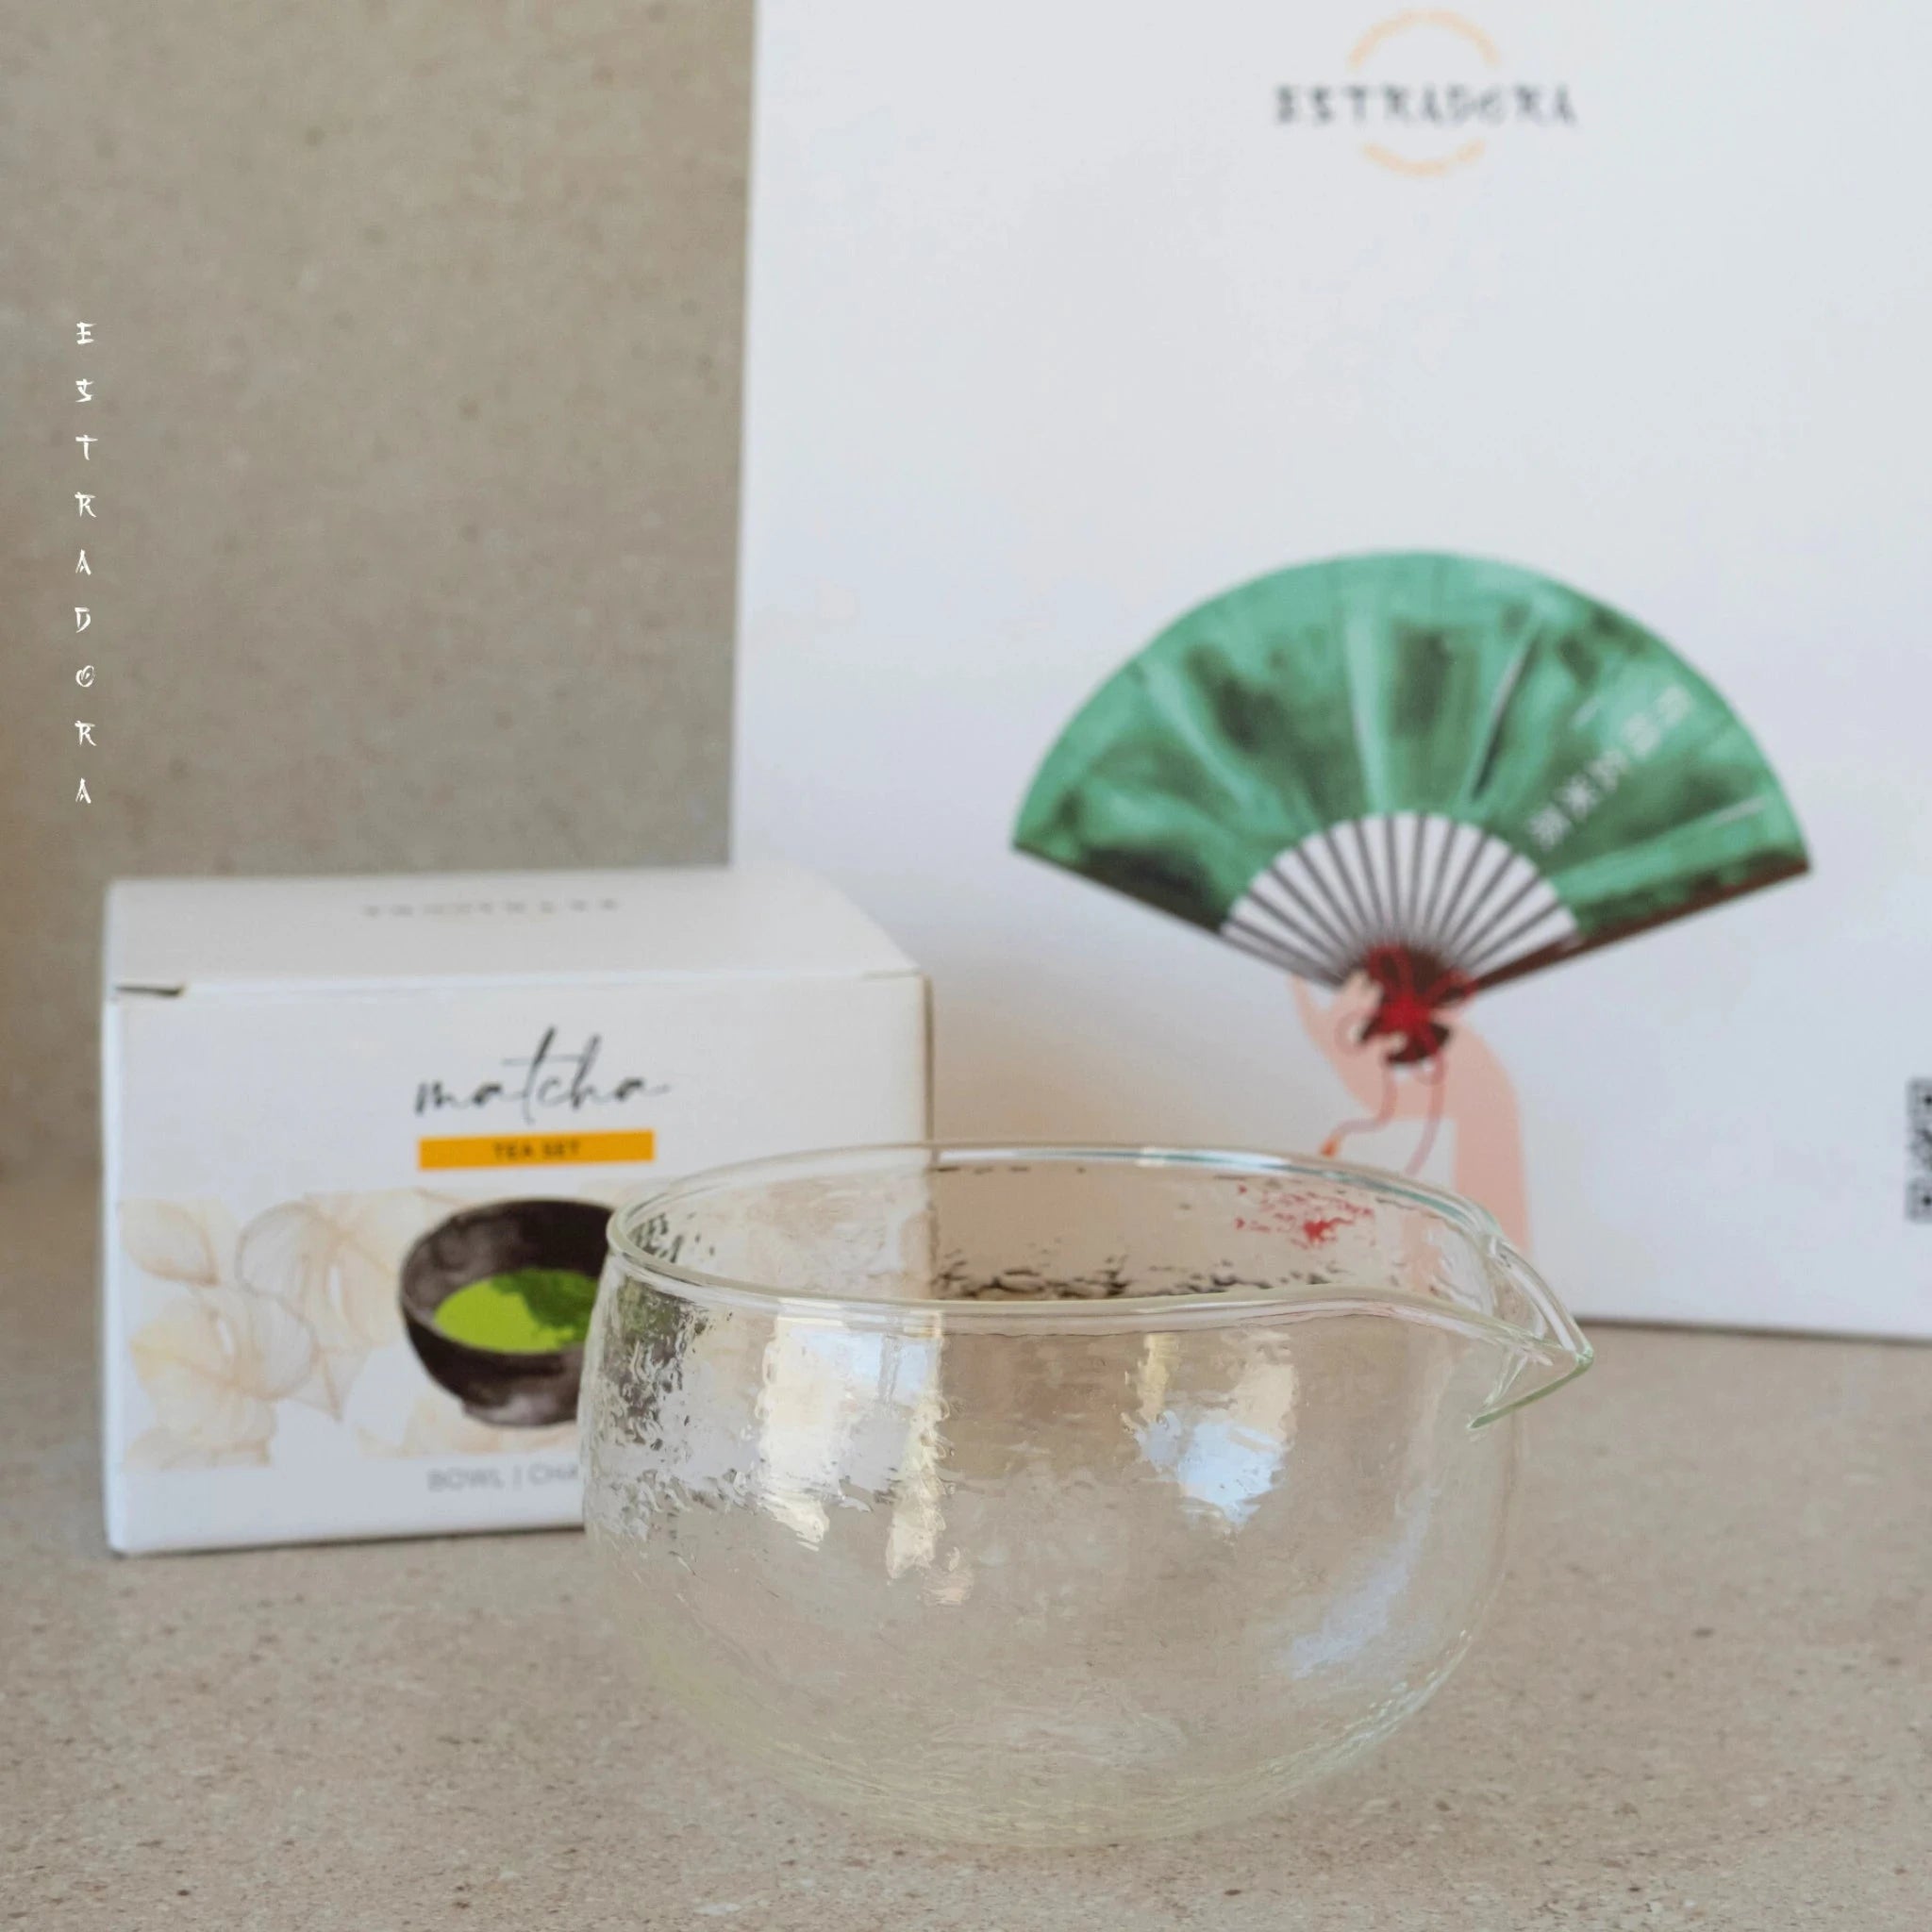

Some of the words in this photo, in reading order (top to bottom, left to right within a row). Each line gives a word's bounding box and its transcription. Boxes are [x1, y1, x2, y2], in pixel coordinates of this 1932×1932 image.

[413, 1024, 671, 1124] matcha
[493, 1141, 533, 1159] TEA
[544, 1139, 580, 1156] SET
[427, 1468, 506, 1491] BOWL
